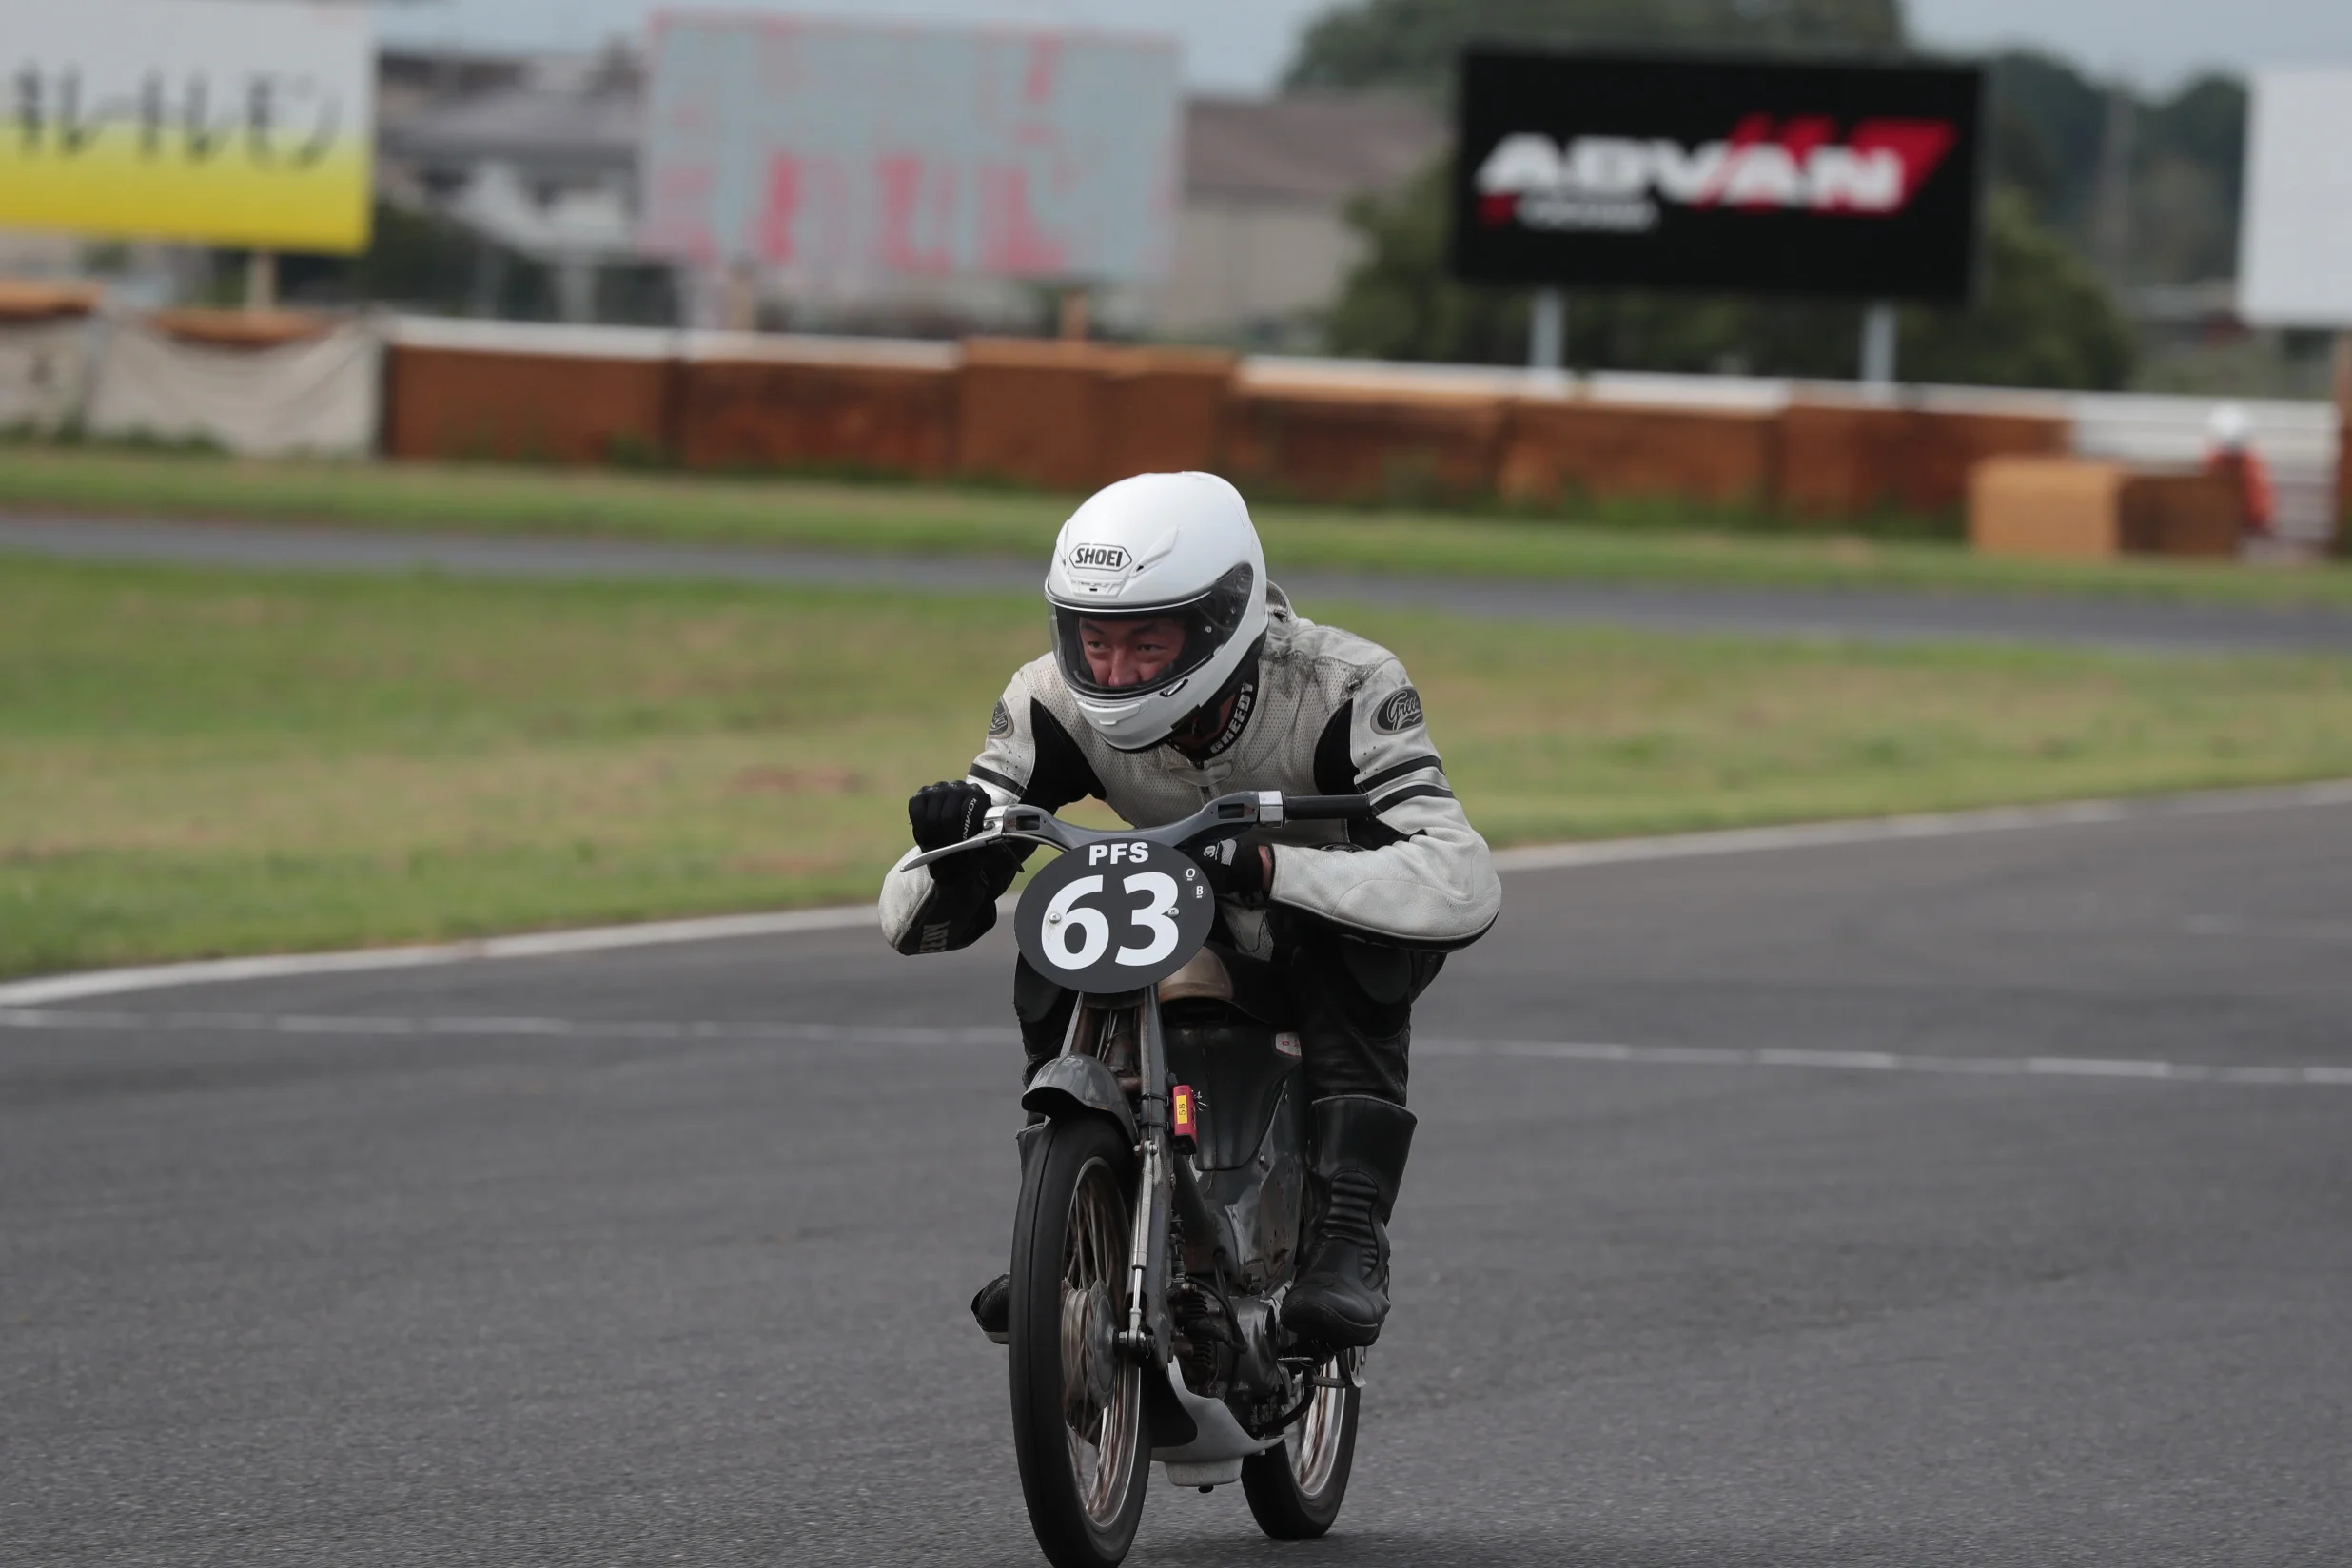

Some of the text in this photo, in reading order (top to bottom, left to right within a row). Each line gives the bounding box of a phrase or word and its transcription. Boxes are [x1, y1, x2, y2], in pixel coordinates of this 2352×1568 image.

[1475, 131, 1906, 211] ADVAN
[1075, 547, 1123, 568] SHOEI
[1088, 841, 1149, 866] PFS
[1196, 885, 1204, 895] B
[1041, 872, 1179, 970] 63
[1178, 1103, 1186, 1116] 58
